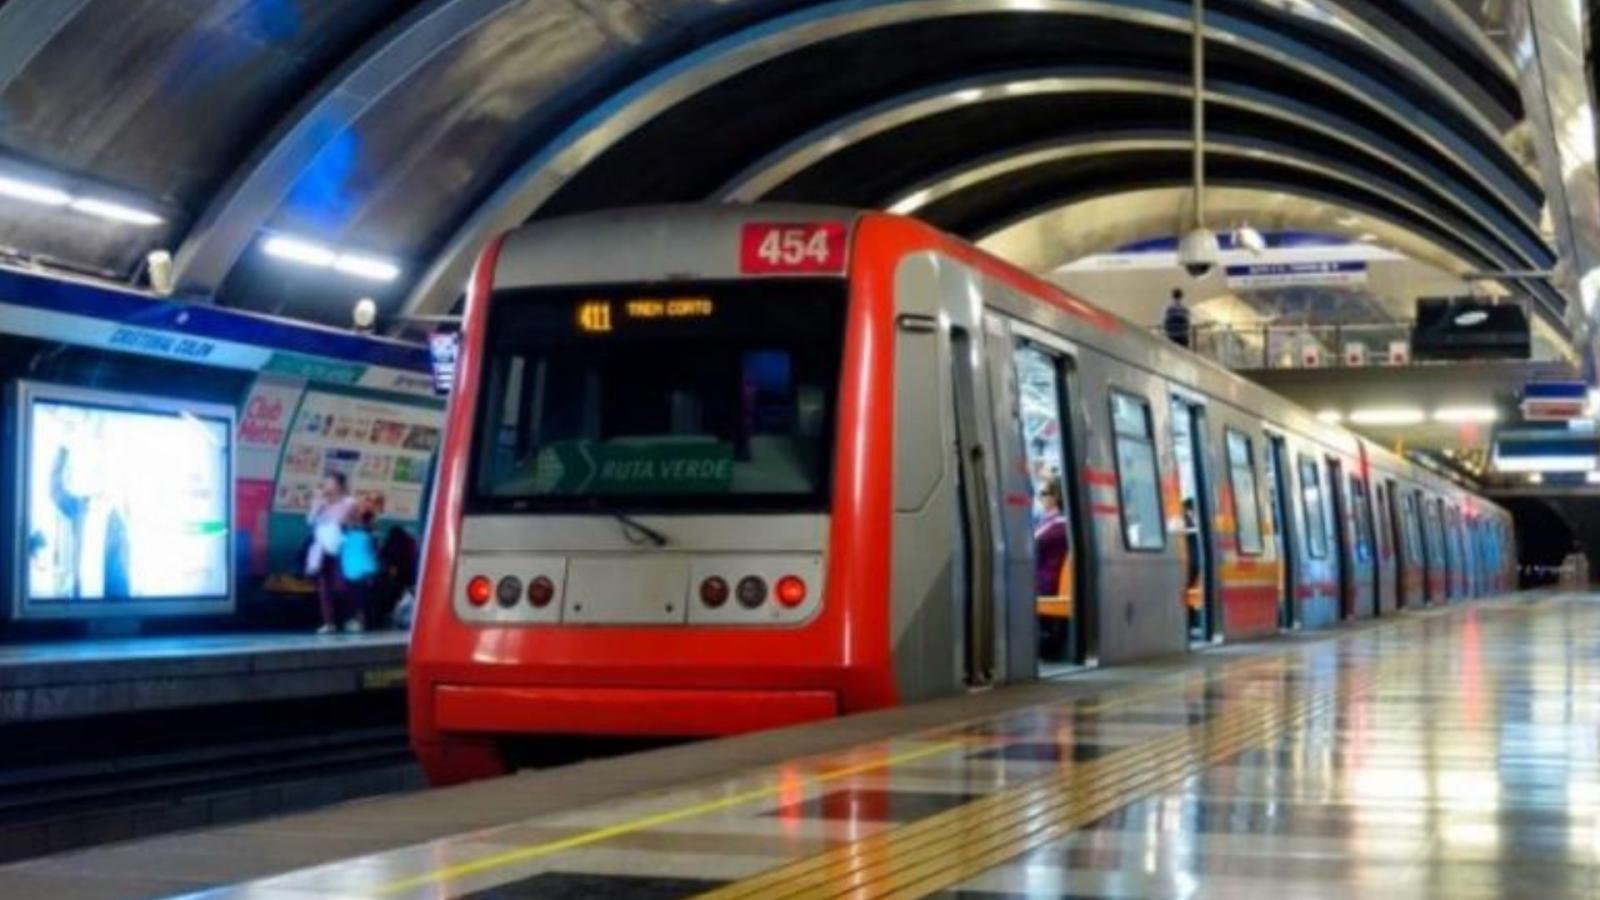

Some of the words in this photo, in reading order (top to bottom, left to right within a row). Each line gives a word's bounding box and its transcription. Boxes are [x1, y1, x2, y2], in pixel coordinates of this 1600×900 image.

[758, 228, 829, 266] 454
[579, 300, 612, 332] 411
[602, 459, 654, 481] RUTA
[660, 458, 731, 480] VERDE
